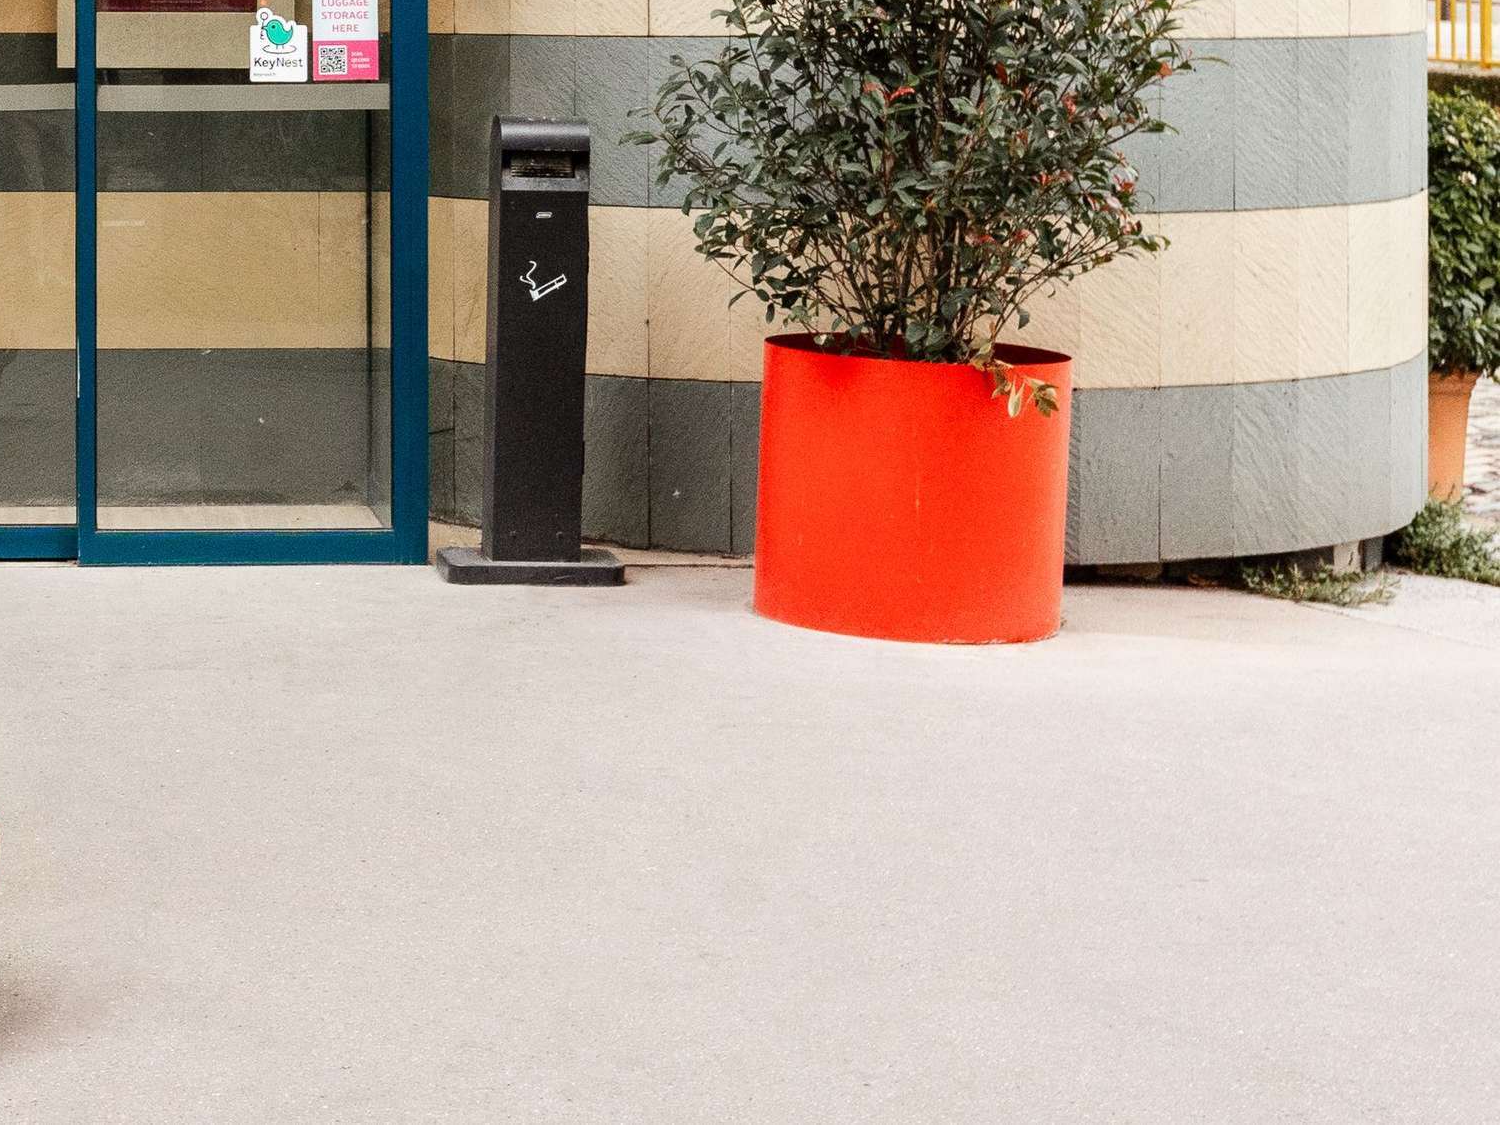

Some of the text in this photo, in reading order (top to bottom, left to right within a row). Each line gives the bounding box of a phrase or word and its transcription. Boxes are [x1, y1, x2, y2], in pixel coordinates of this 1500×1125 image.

[321, 11, 370, 20] STORAGE
[332, 24, 360, 33] HERE
[253, 57, 304, 70] KeyNest
